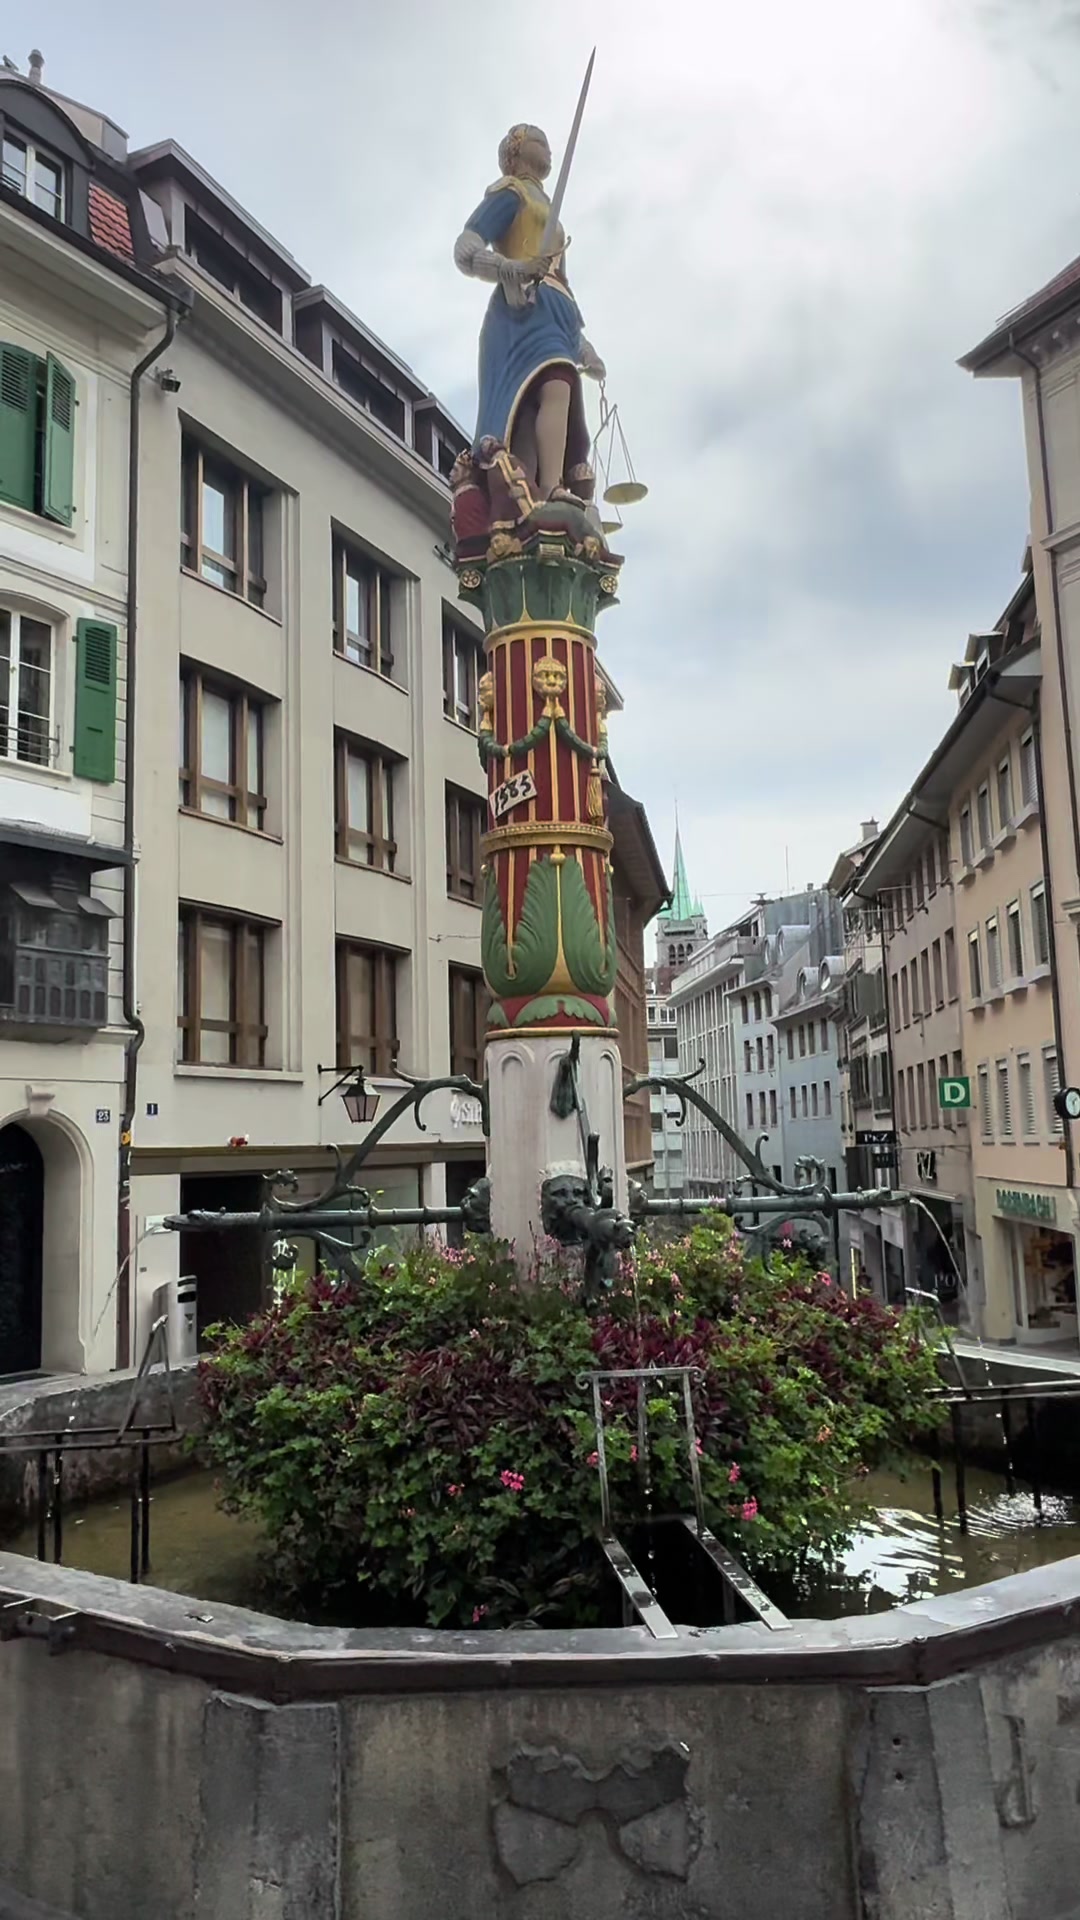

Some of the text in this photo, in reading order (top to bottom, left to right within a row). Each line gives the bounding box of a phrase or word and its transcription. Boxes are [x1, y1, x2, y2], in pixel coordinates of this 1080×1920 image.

[495, 774, 531, 816] 1585
[944, 1082, 966, 1103] D
[98, 1110, 109, 1121] 23
[864, 1133, 889, 1142] PKZ
